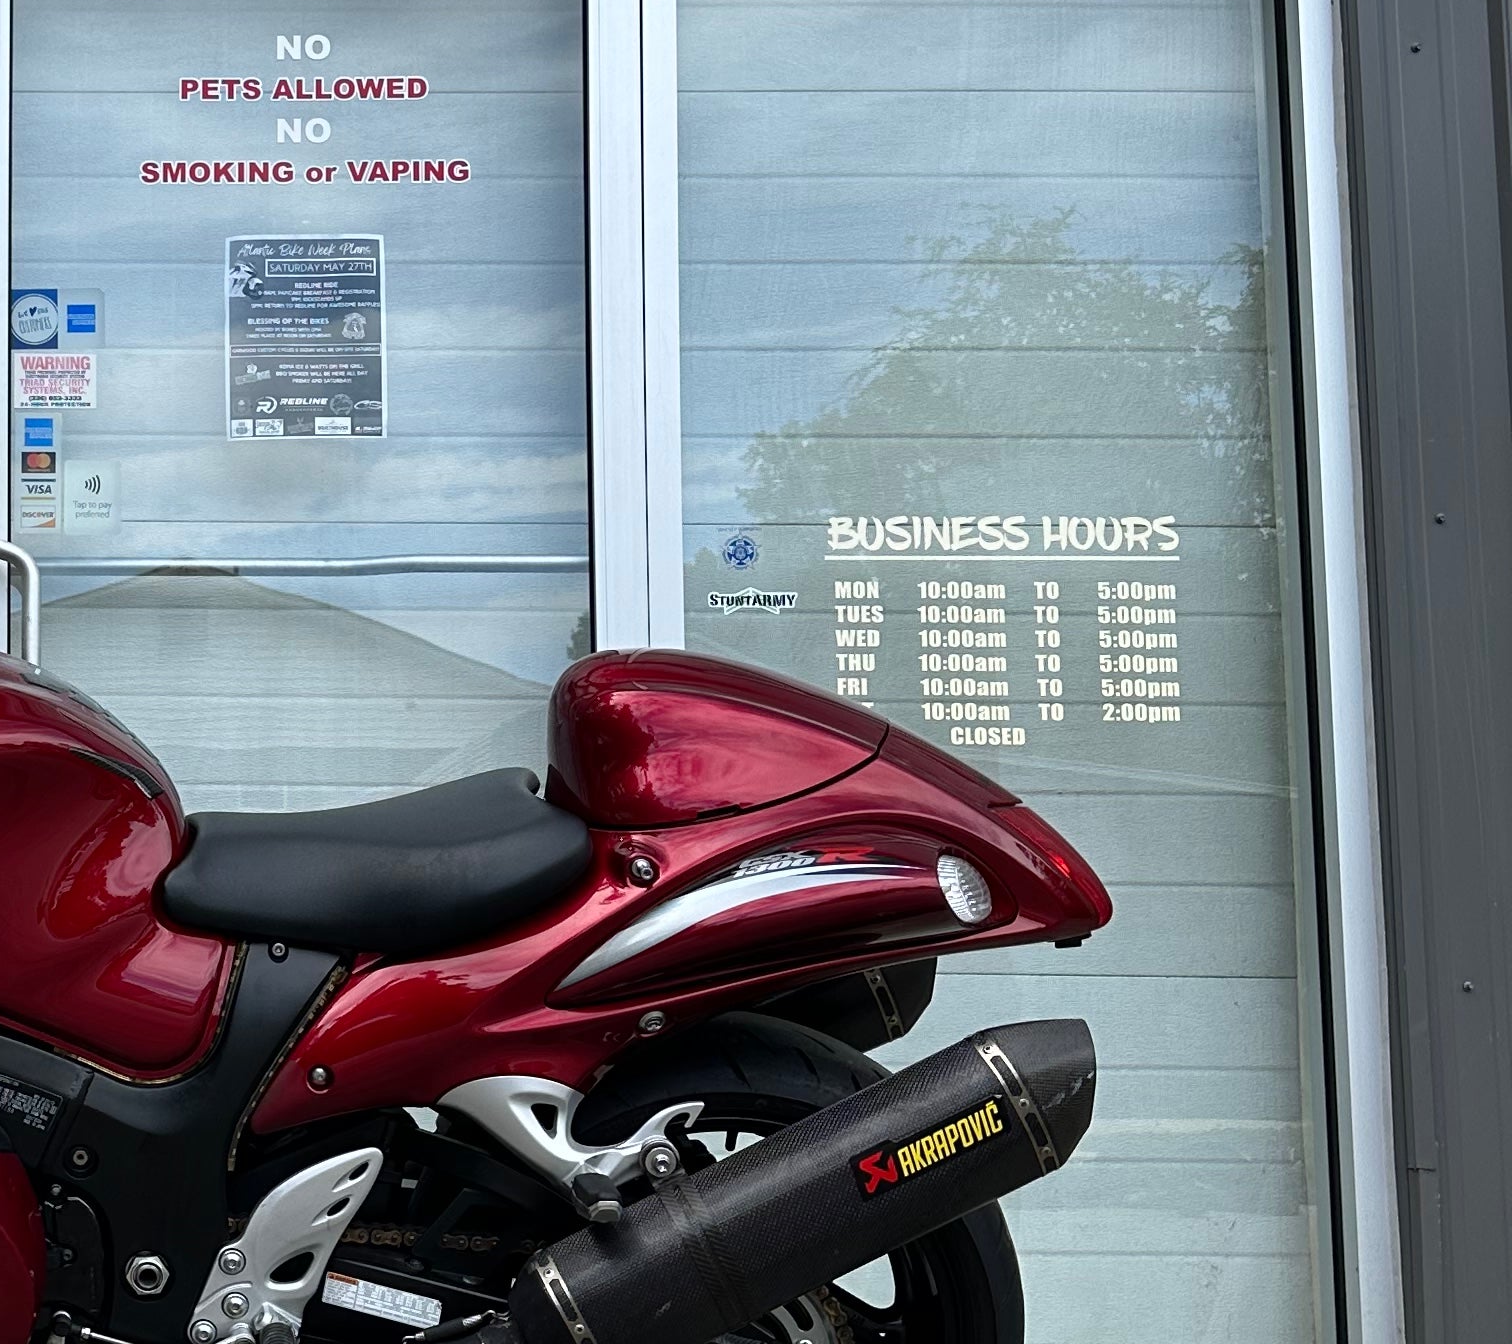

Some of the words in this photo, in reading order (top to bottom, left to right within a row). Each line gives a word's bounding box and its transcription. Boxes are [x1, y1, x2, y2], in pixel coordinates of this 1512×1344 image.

[275, 33, 332, 61] NO
[178, 77, 263, 102] PETS
[272, 76, 429, 101] ALLOWED
[275, 117, 332, 144] NO
[139, 161, 295, 185] SMOKING
[304, 165, 338, 185] or
[346, 159, 471, 184] VAPING
[278, 243, 304, 256] Bike
[308, 243, 336, 256] Week
[269, 263, 320, 273] SATURDAY
[322, 263, 346, 272] MAY
[347, 262, 373, 272] 27TH
[20, 356, 91, 370] WARNING
[19, 378, 45, 387] TRIAD
[48, 378, 91, 387] SECURITY
[279, 397, 328, 405] REDLINE
[25, 485, 52, 494] VISA
[22, 511, 55, 519] DISCOVER
[72, 500, 87, 509] Tap
[75, 510, 110, 519] preferred
[827, 515, 1030, 553] BUSINESS
[1041, 515, 1181, 552] HOURS
[835, 581, 880, 600] MON
[917, 581, 1006, 600] 10:00am
[1033, 581, 1059, 600] TO
[1097, 581, 1176, 602] 5:00pm
[835, 605, 884, 624] TUES
[916, 605, 1006, 624] 10:00am
[1033, 605, 1059, 624] TO
[1097, 605, 1176, 626] 5:00pm
[835, 629, 880, 649] WED
[918, 629, 1006, 649] 10:00am
[1035, 629, 1060, 649] TO
[1098, 629, 1178, 651] 5:00pm
[836, 653, 875, 673] THU
[918, 653, 1006, 673] 10:00am
[1035, 653, 1060, 673] TO
[1098, 653, 1178, 675] 5:00pm
[837, 677, 869, 697] FRI
[920, 677, 1009, 697] 10:00am
[1037, 677, 1063, 697] TO
[1101, 677, 1180, 699] 5:00pm
[921, 702, 1010, 722] 10:00am
[1038, 702, 1064, 722] TO
[1102, 702, 1181, 724] 2:00pm
[950, 727, 1026, 746] CLOSED
[733, 856, 816, 879] 1300
